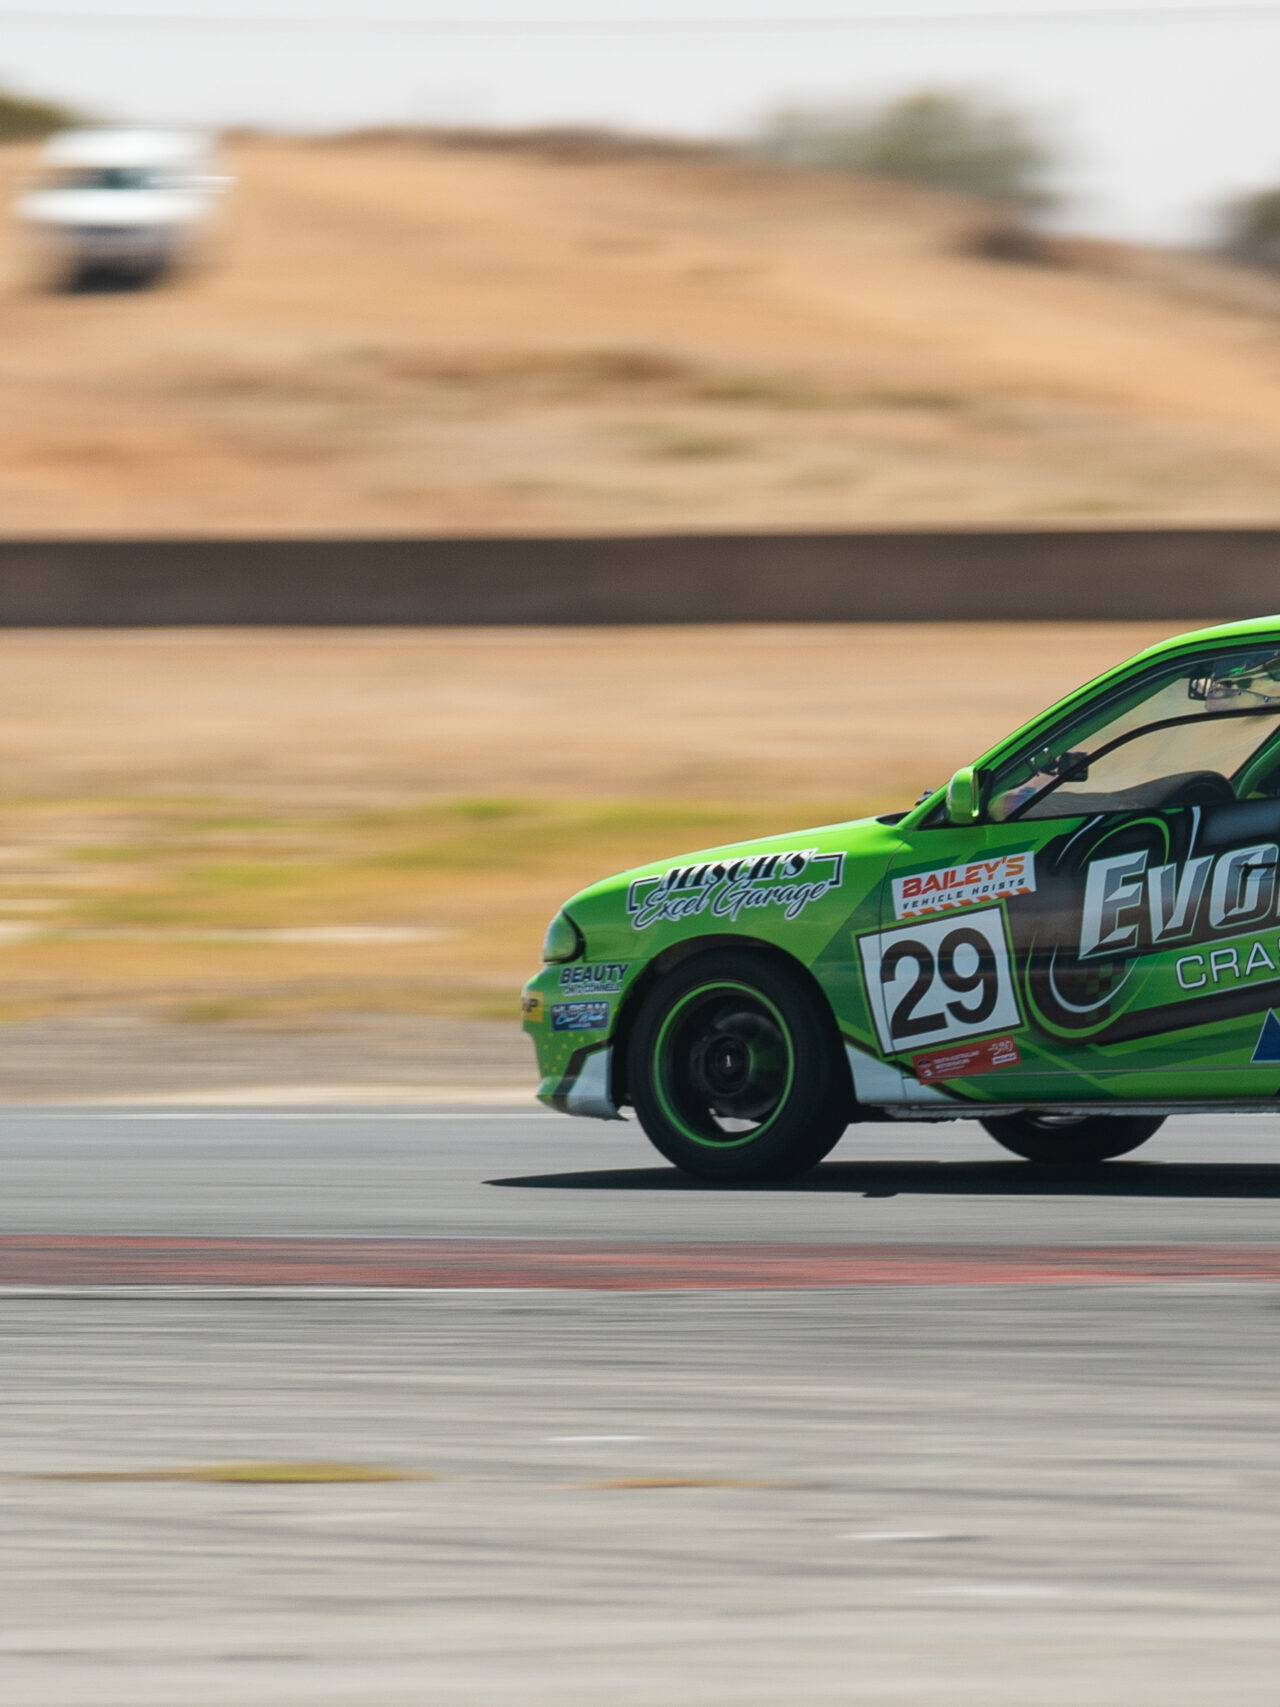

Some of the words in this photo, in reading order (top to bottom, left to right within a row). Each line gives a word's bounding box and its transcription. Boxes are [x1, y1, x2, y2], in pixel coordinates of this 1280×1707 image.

[902, 856, 1025, 899] BAILEY'S
[902, 891, 964, 910] VEHICLE
[972, 878, 1026, 896] HOISTS
[633, 883, 716, 929] Excel
[713, 880, 829, 921] Garage
[559, 963, 630, 985] BEAUTY
[880, 927, 998, 1040] 29
